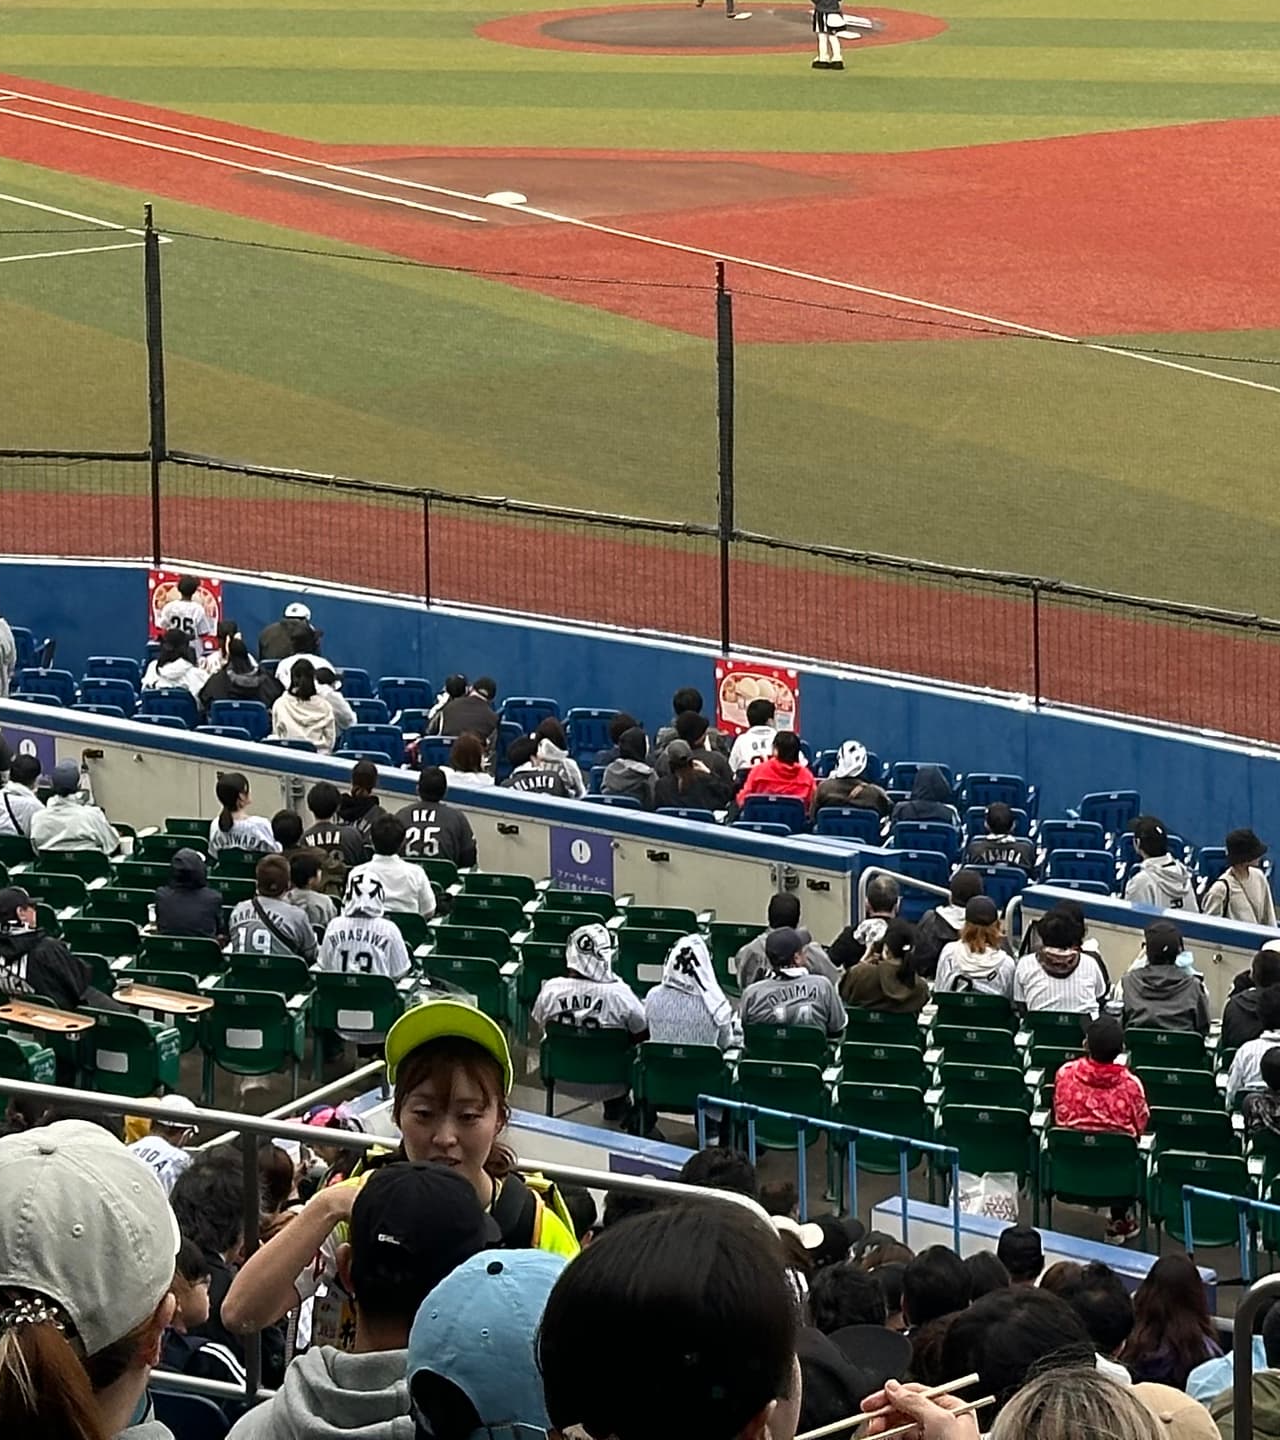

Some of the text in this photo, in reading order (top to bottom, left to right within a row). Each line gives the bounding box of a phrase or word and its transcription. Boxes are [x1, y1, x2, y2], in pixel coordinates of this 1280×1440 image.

[412, 809, 436, 823] OKA
[305, 831, 341, 847] WADA
[404, 826, 441, 857] 25
[233, 907, 284, 926] KARAAWA
[329, 928, 389, 952] HIRASAWA
[557, 996, 602, 1013] WADA
[769, 986, 819, 1007] OJIMA
